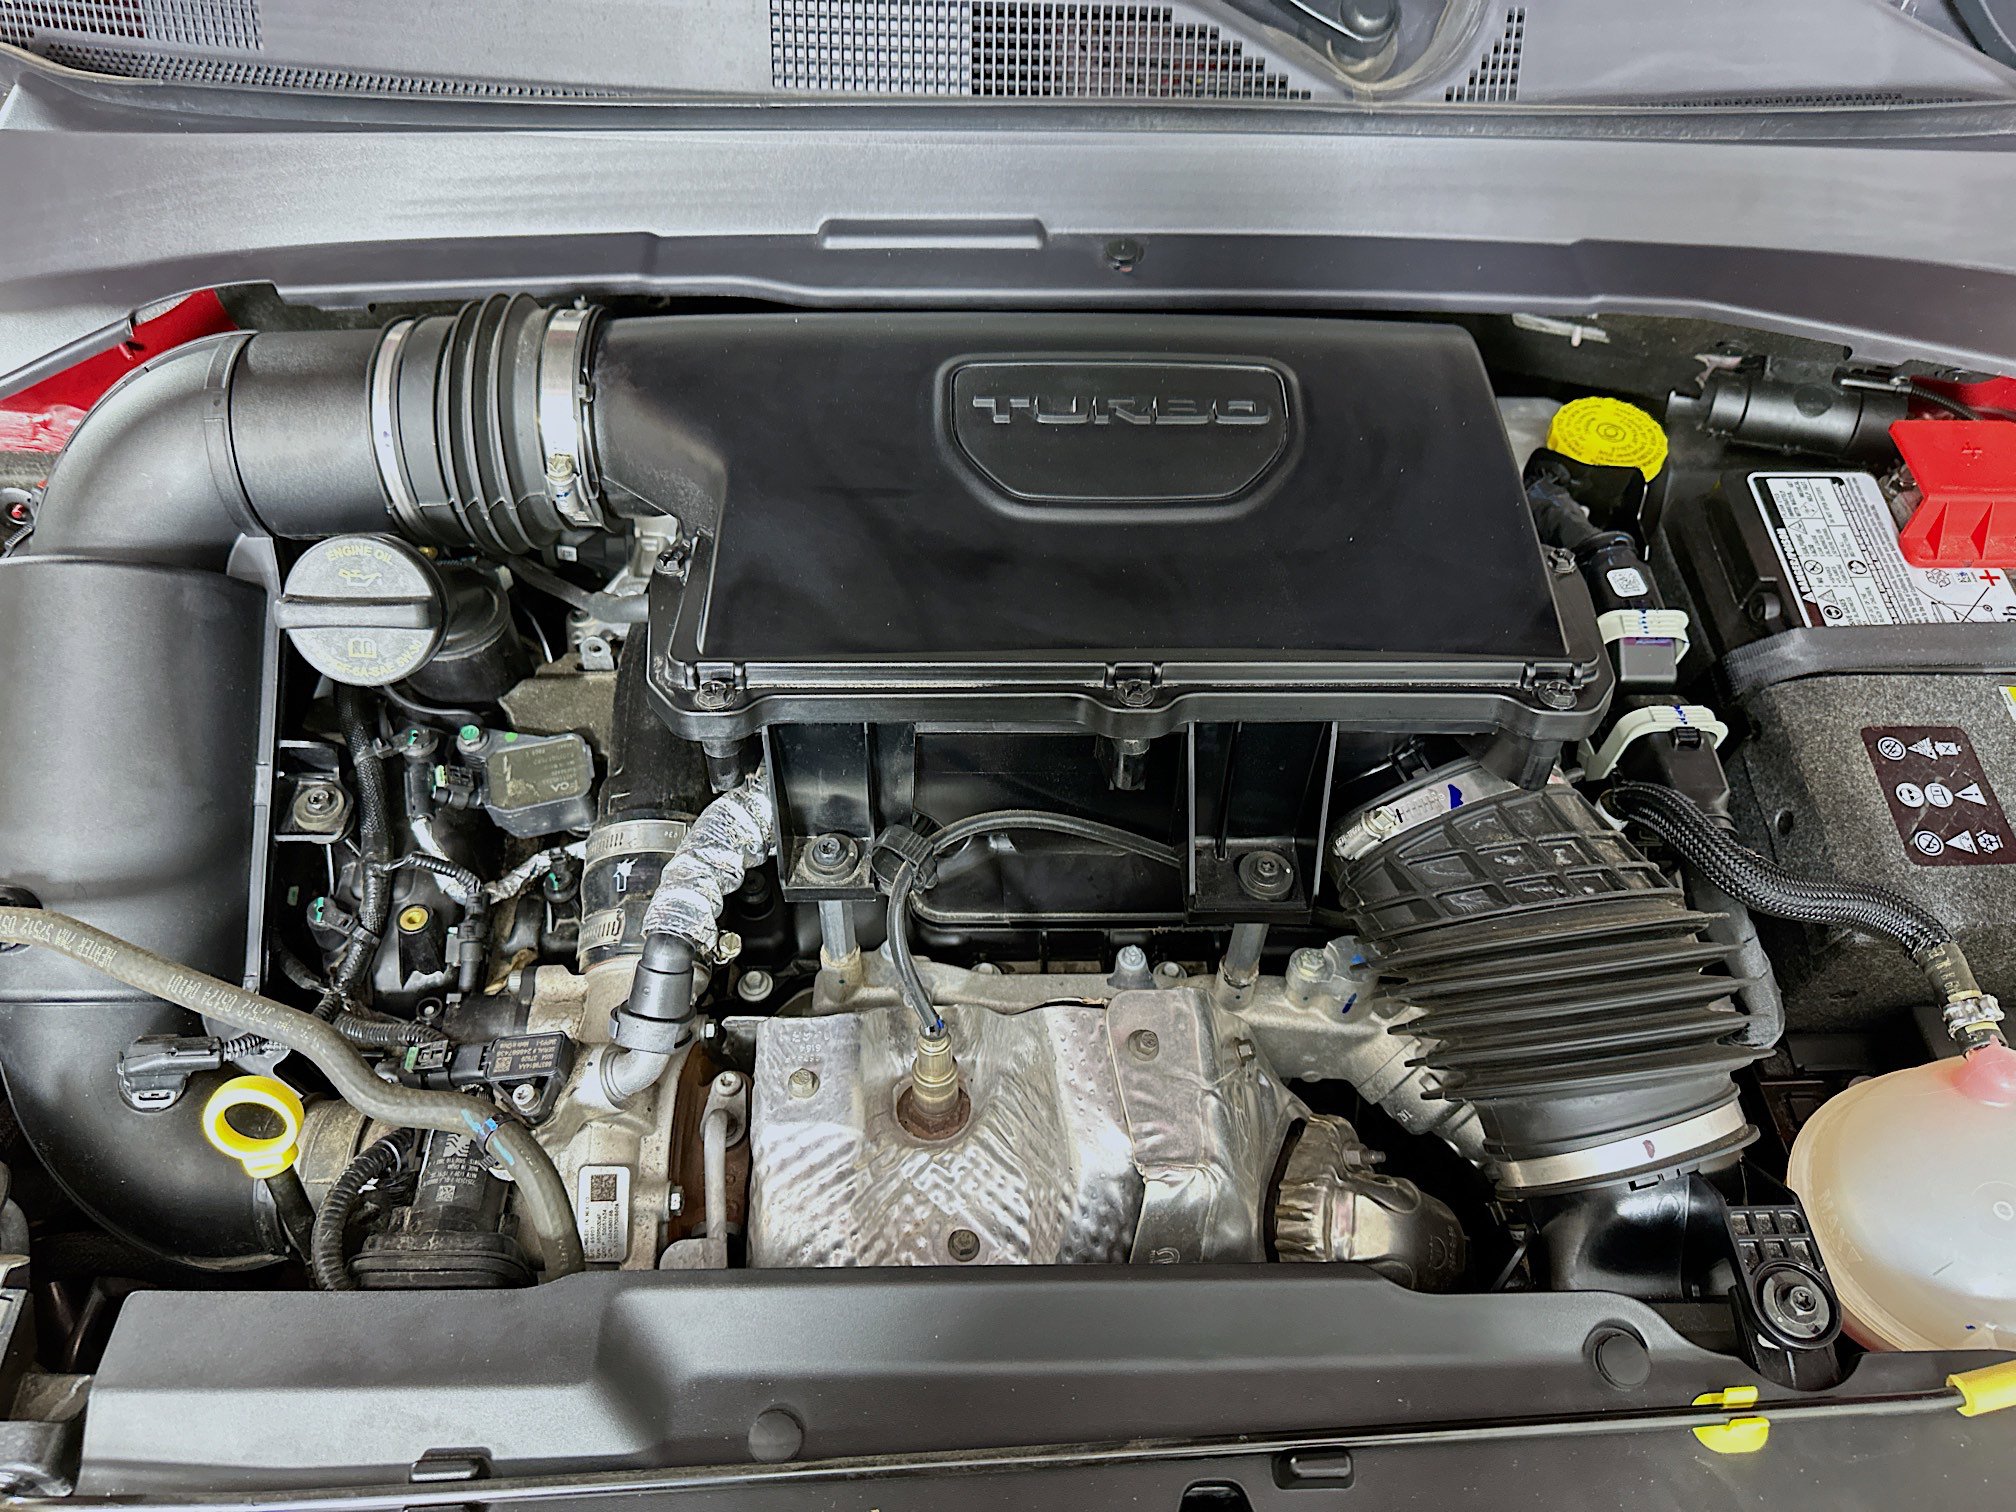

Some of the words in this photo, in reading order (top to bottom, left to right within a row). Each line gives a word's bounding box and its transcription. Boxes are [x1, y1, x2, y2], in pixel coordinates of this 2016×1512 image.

[972, 395, 1271, 425] TURBO
[325, 544, 372, 562] ENGINE
[372, 550, 394, 565] OIL
